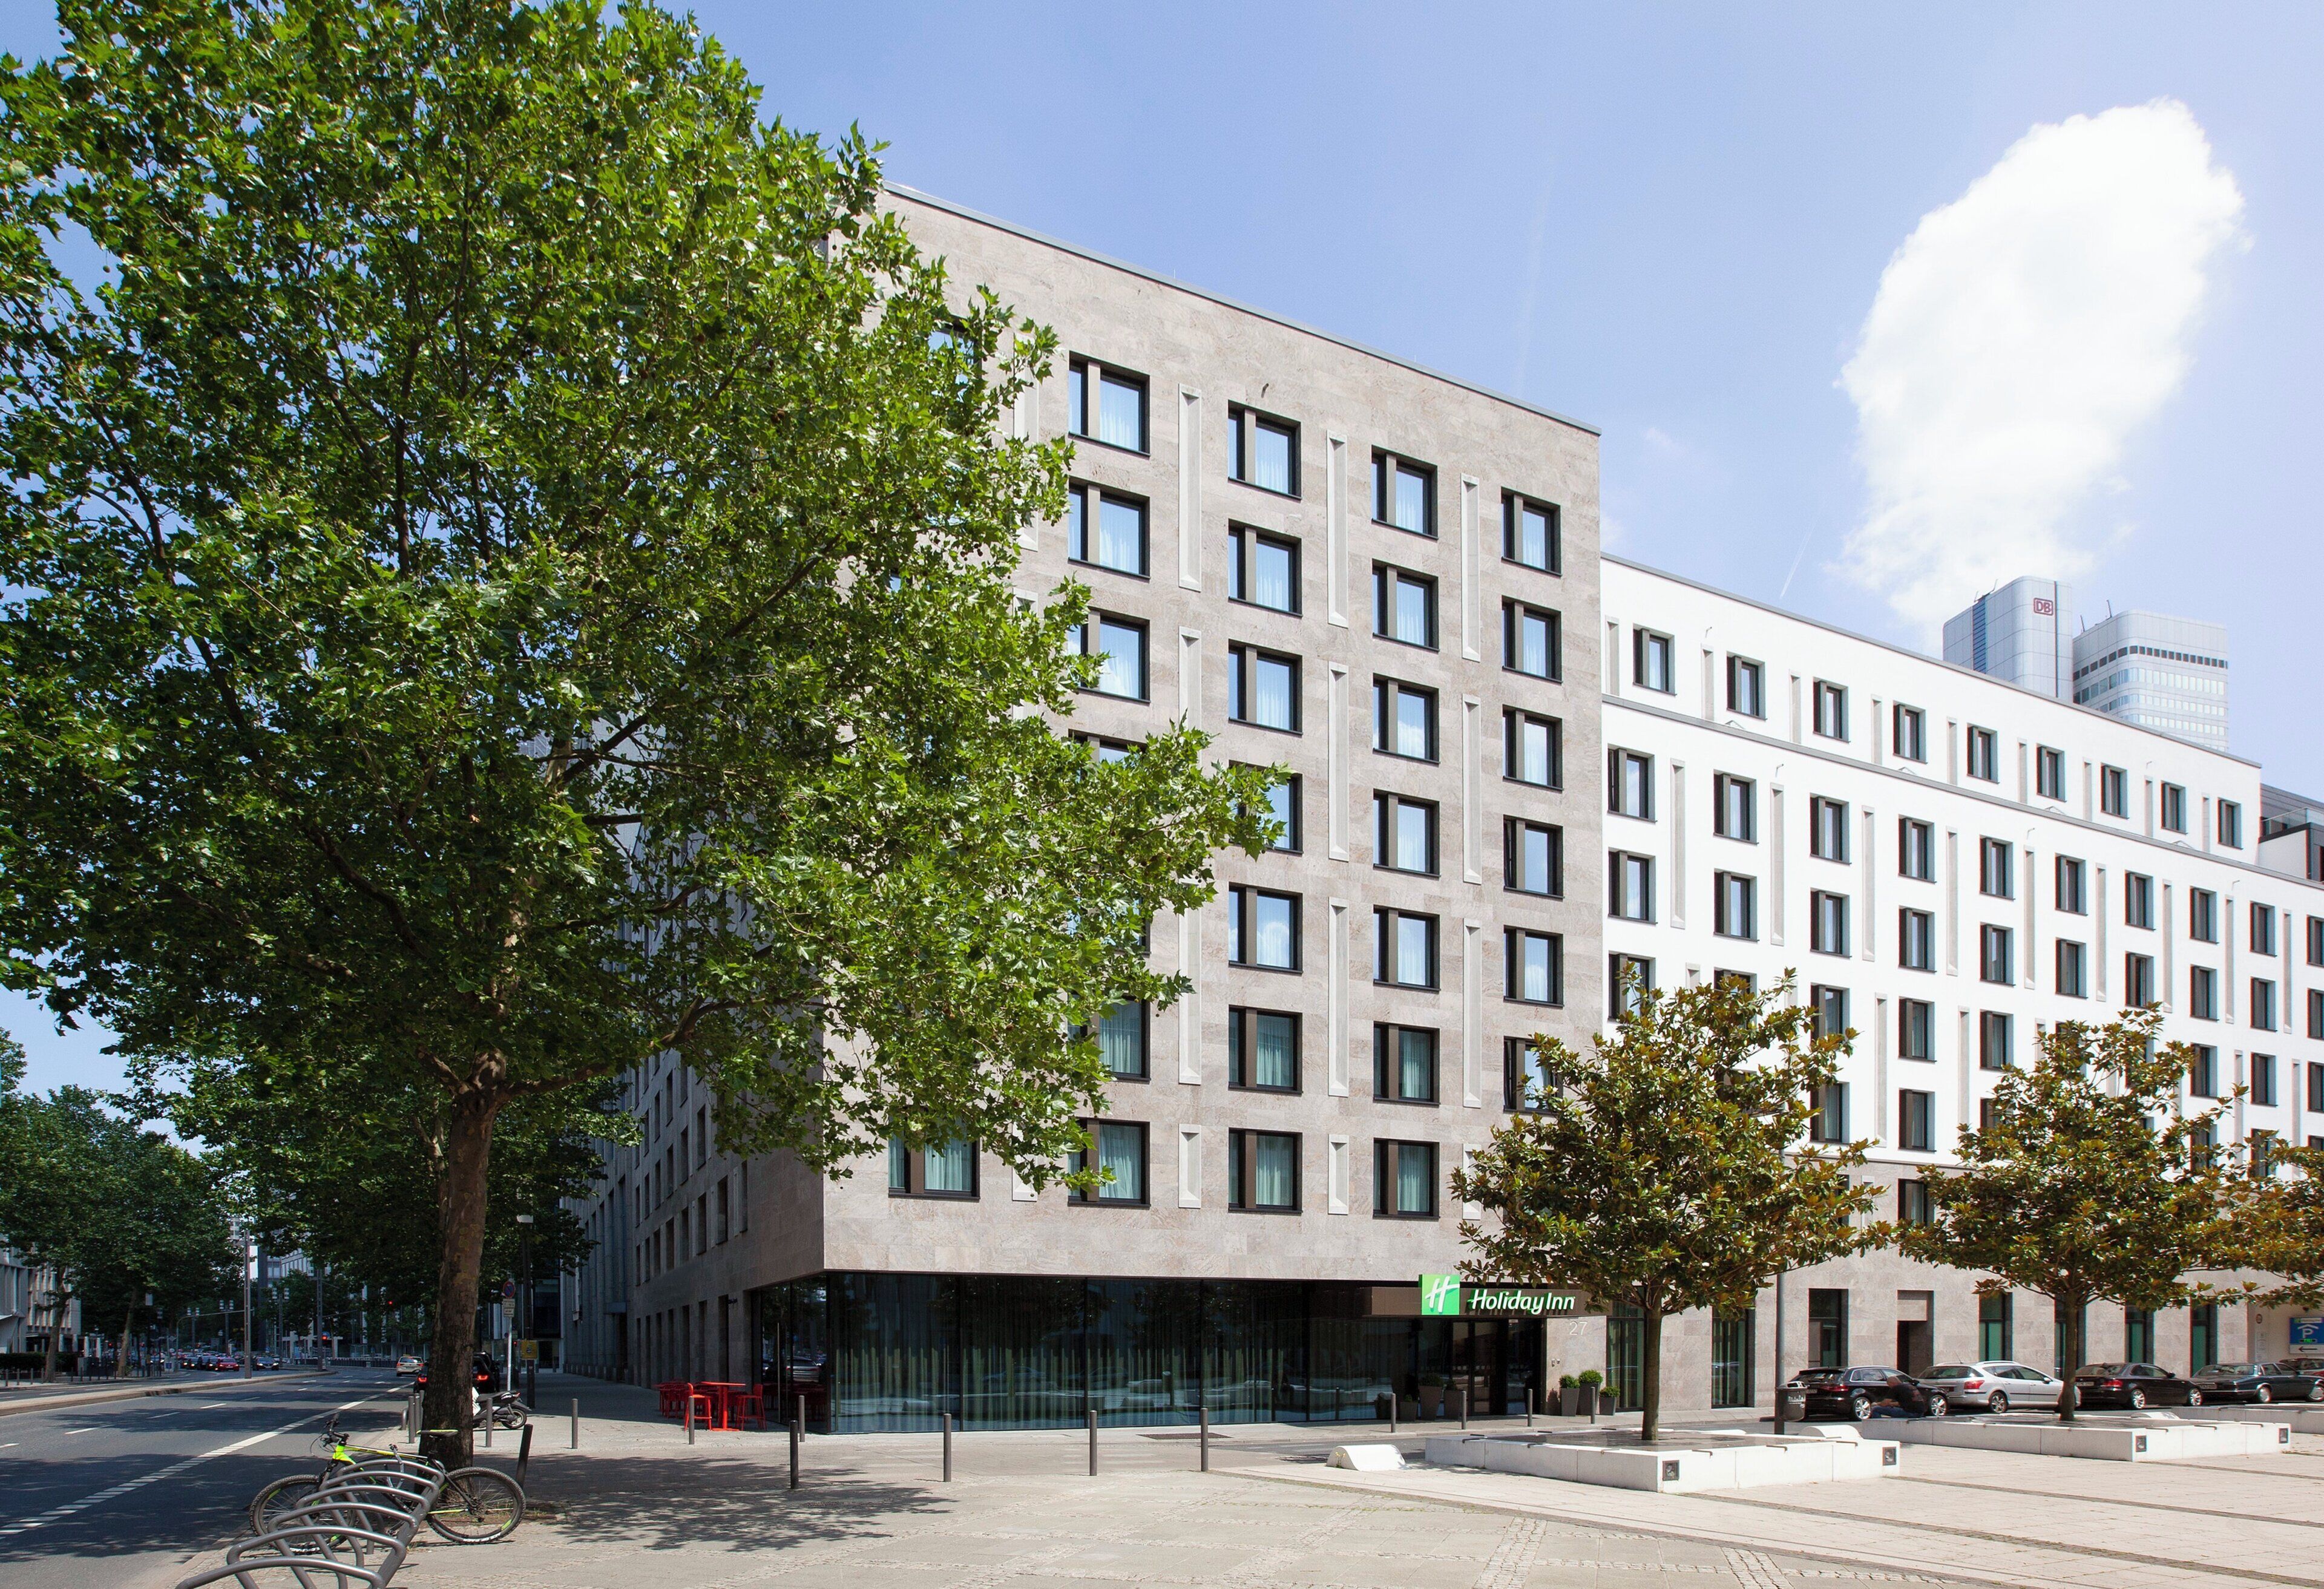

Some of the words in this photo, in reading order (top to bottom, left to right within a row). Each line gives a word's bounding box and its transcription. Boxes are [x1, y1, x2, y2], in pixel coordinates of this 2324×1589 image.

[2036, 600, 2051, 612] DB
[1469, 1289, 1544, 1315] Holiday
[1546, 1292, 1575, 1310] Inn
[1569, 1320, 1588, 1336] 27
[2302, 1328, 2313, 1338] P
